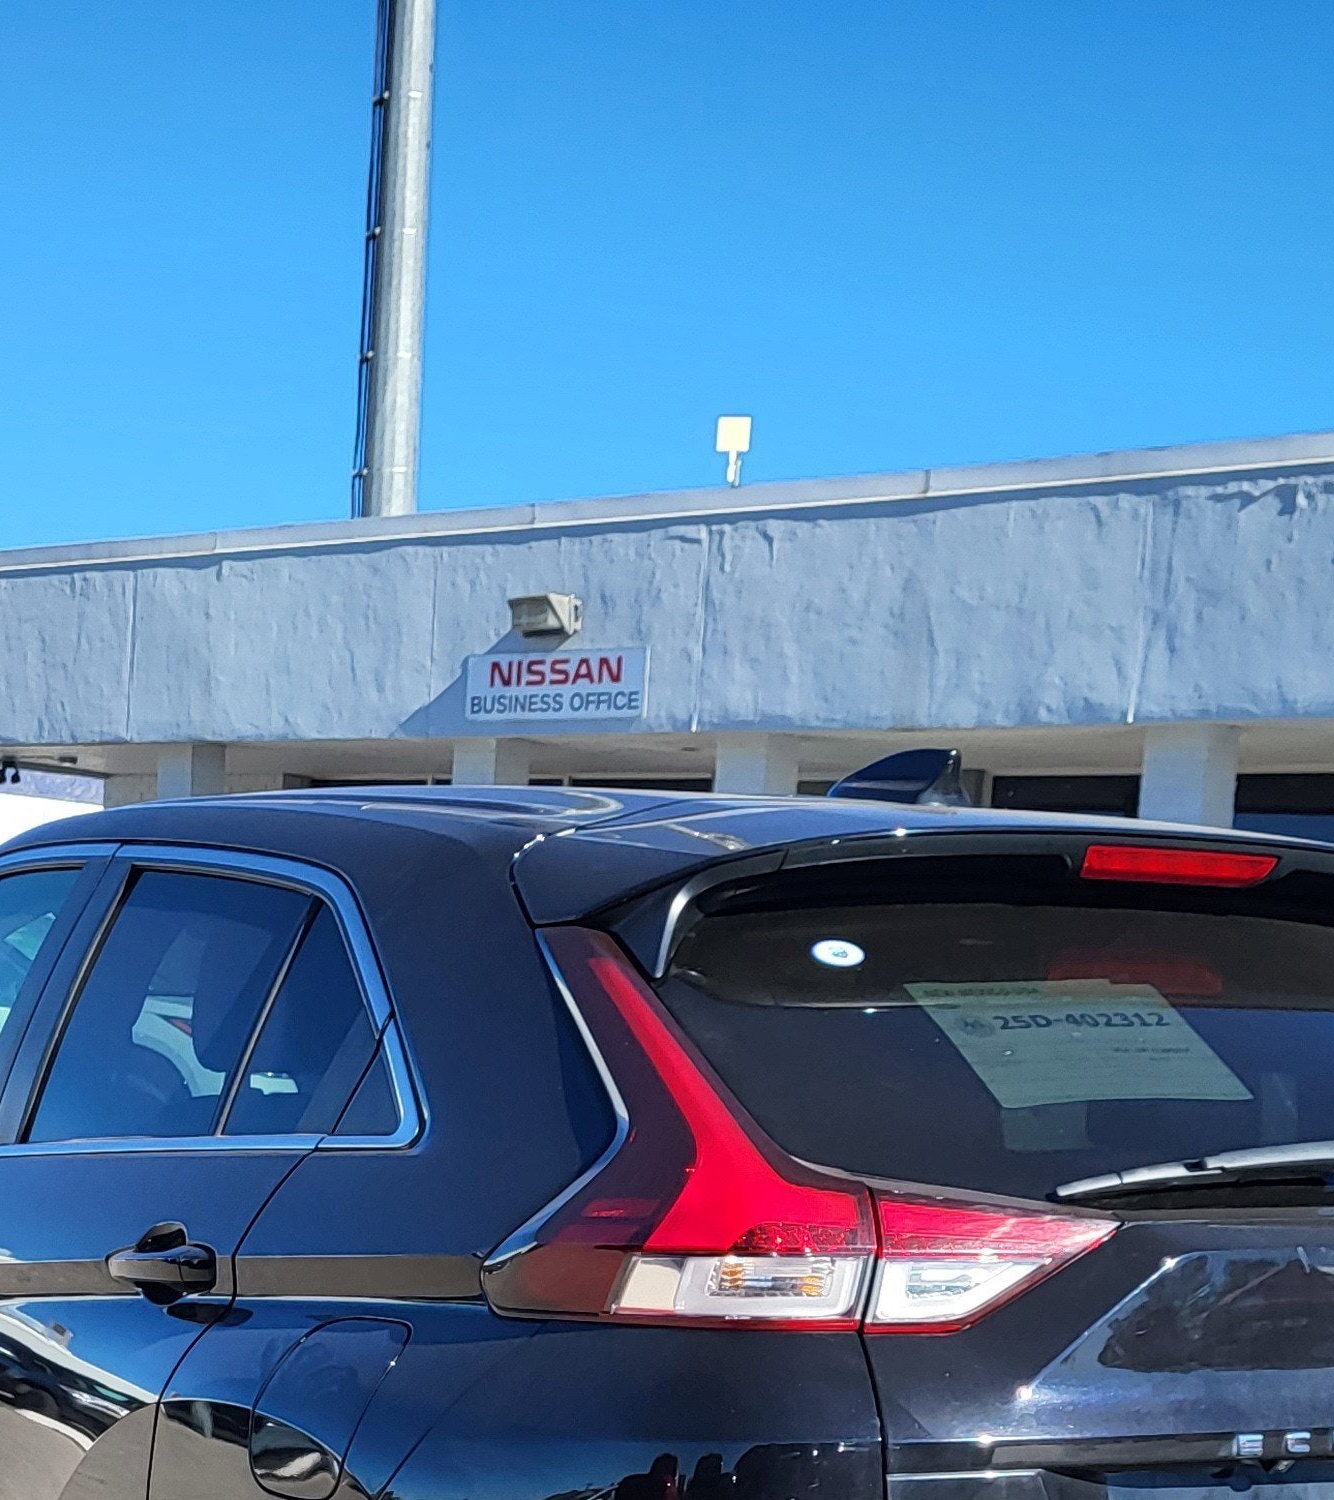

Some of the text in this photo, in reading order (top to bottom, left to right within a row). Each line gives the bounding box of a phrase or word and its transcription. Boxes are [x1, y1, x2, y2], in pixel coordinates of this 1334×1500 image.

[489, 655, 624, 688] NISSAN
[469, 690, 640, 715] BUSINESS OFFICE
[993, 1012, 1171, 1031] 25D-402312
